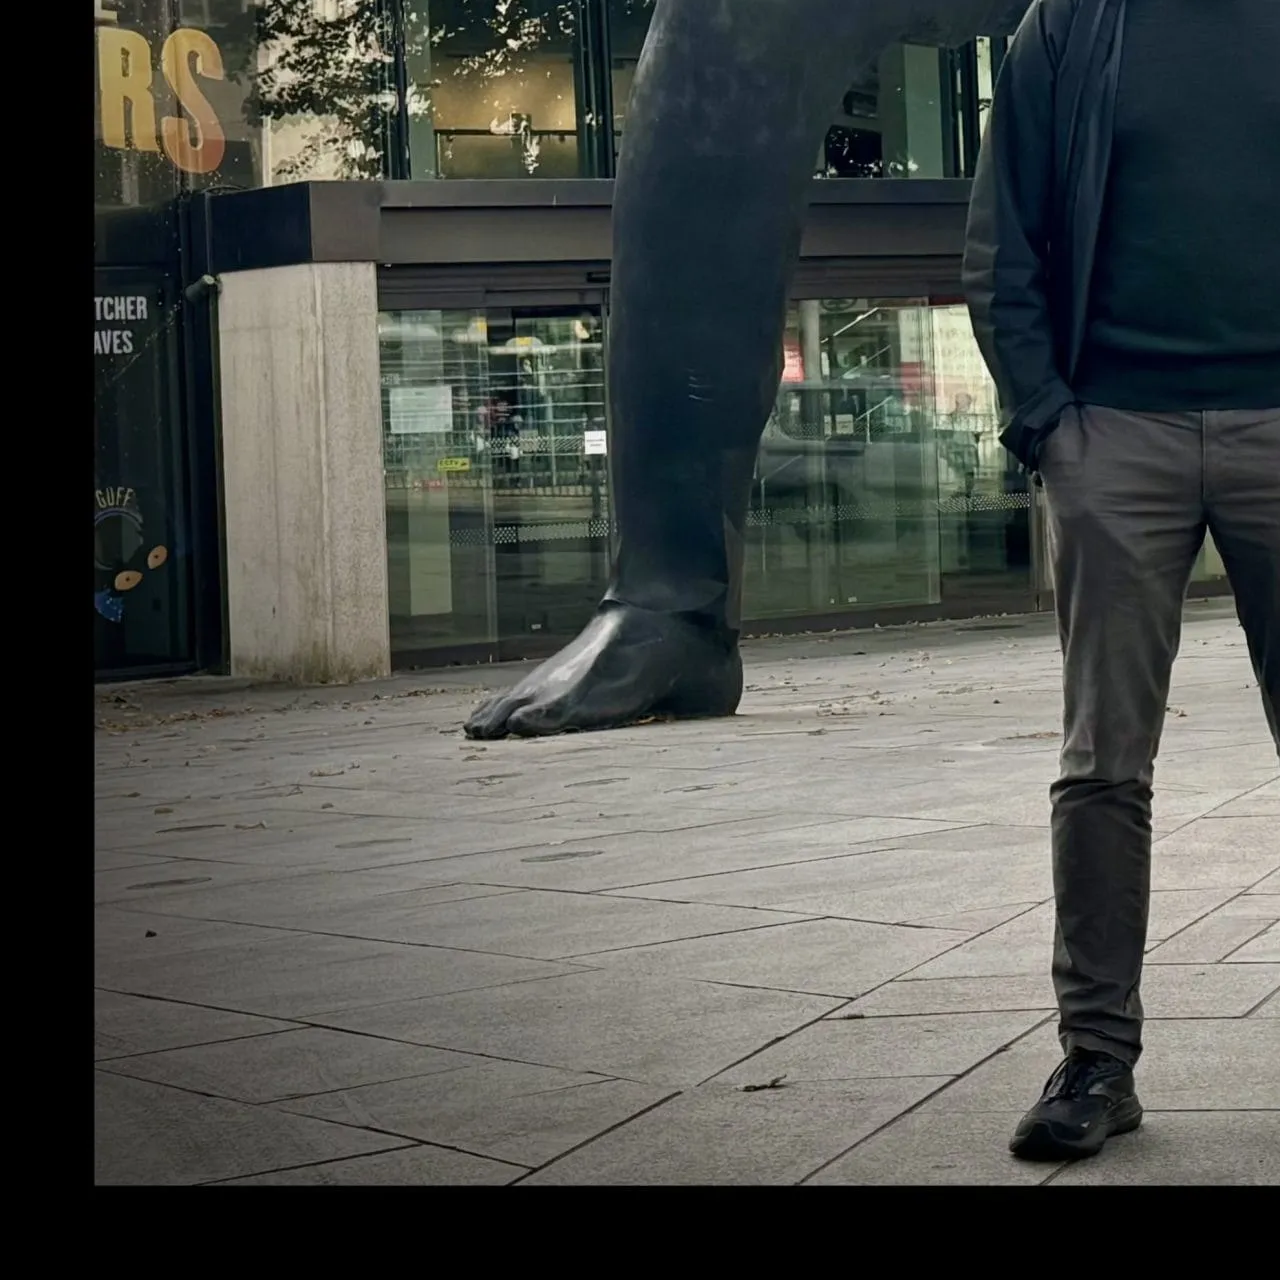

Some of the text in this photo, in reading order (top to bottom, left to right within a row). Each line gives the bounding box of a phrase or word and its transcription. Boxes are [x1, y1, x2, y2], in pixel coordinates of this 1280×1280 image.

[98, 26, 226, 174] RS
[93, 296, 148, 320] TCHER
[93, 329, 134, 355] AVES
